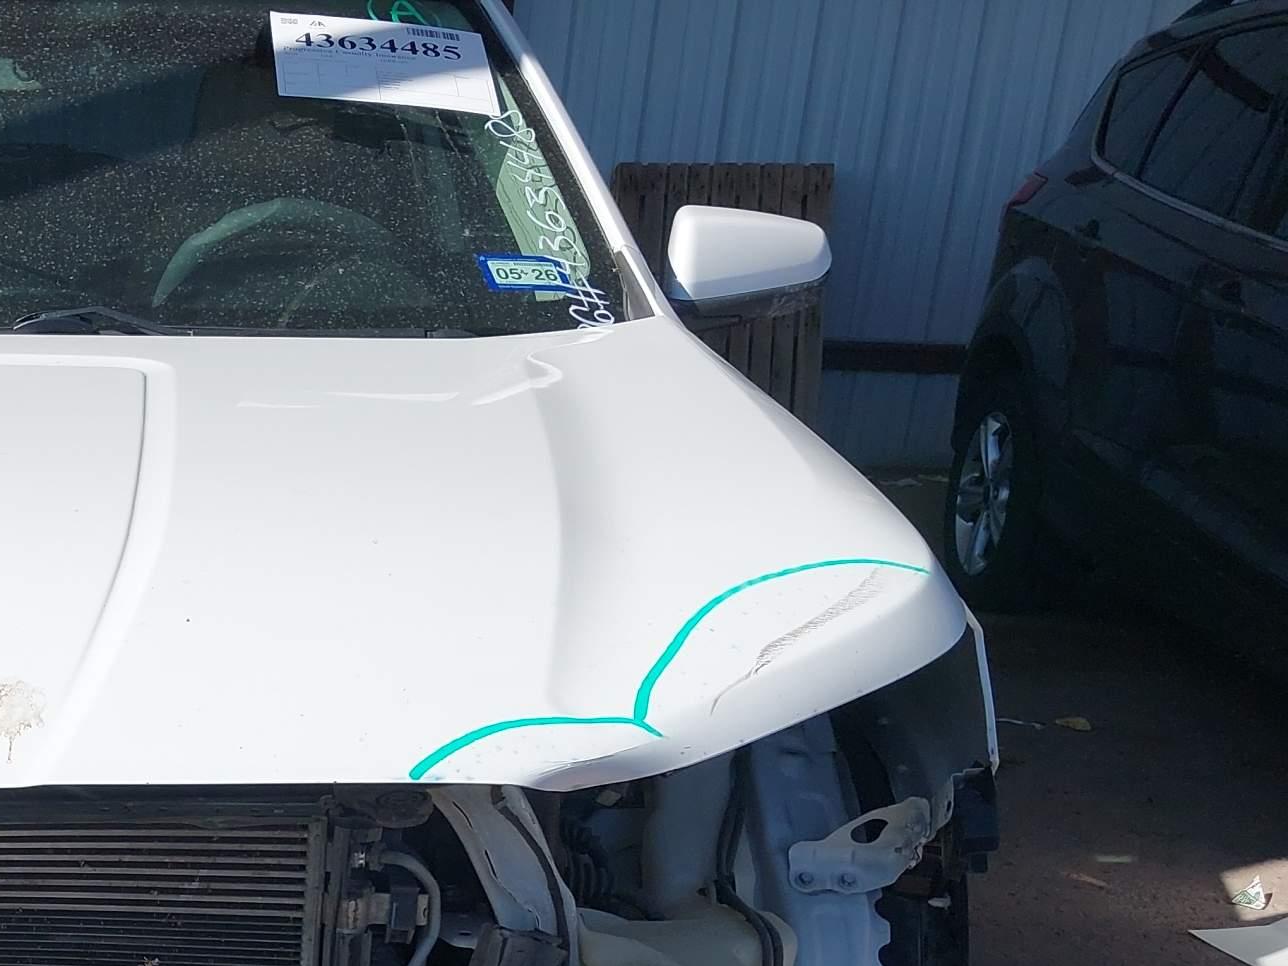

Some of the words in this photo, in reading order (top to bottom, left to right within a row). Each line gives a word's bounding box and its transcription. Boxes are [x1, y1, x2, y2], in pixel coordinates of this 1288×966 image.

[295, 32, 462, 61] 43634485
[495, 267, 522, 280] 05
[531, 268, 558, 281] 26
